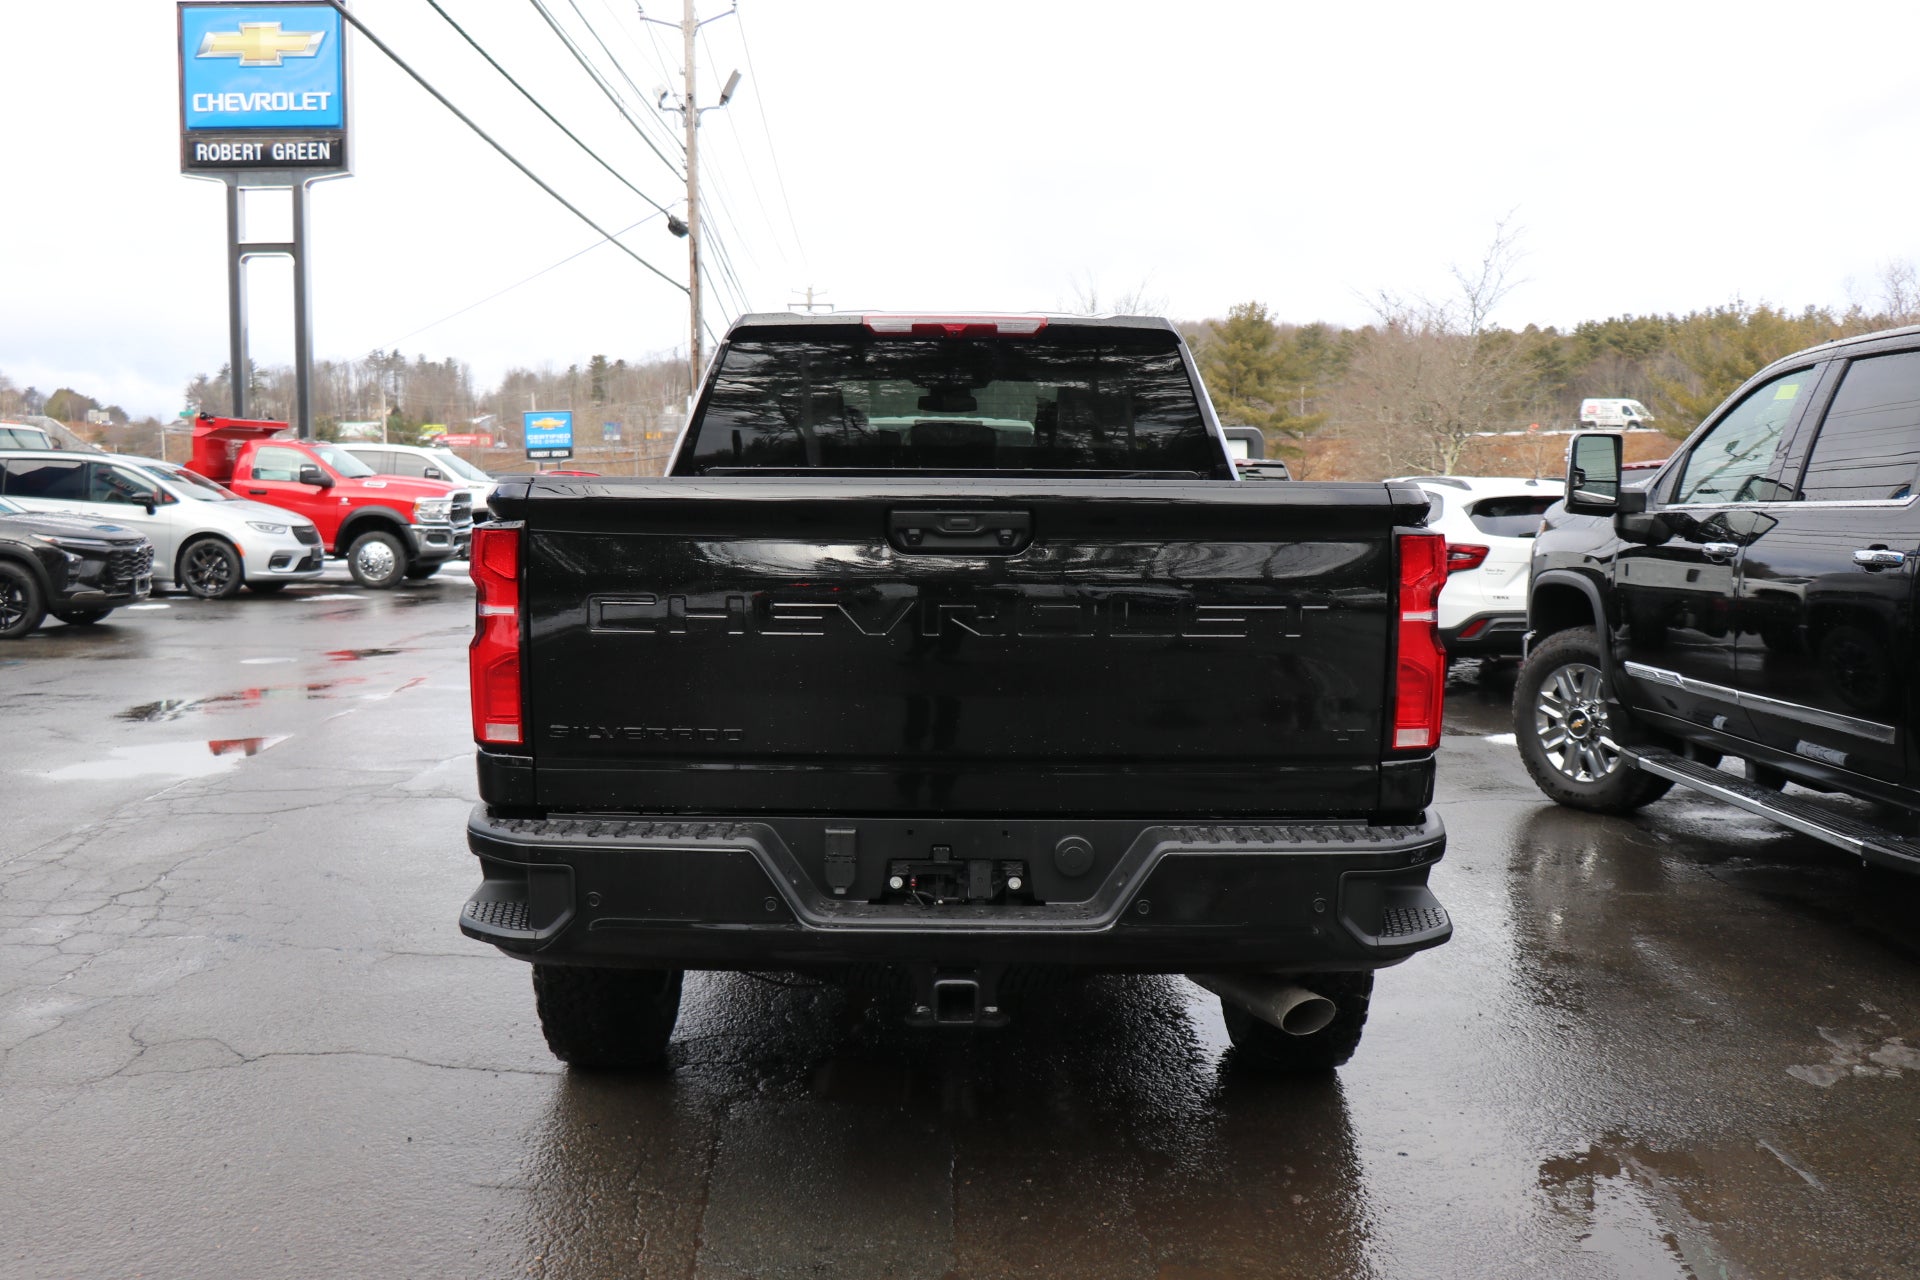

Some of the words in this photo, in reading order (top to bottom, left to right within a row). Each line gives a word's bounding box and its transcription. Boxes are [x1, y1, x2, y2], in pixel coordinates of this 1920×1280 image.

[193, 92, 331, 112] CHEVROLET
[196, 143, 263, 162] ROBERT
[272, 142, 330, 161] GREEN
[586, 592, 1331, 638] CHEVROLET
[549, 724, 744, 742] SILVERADO
